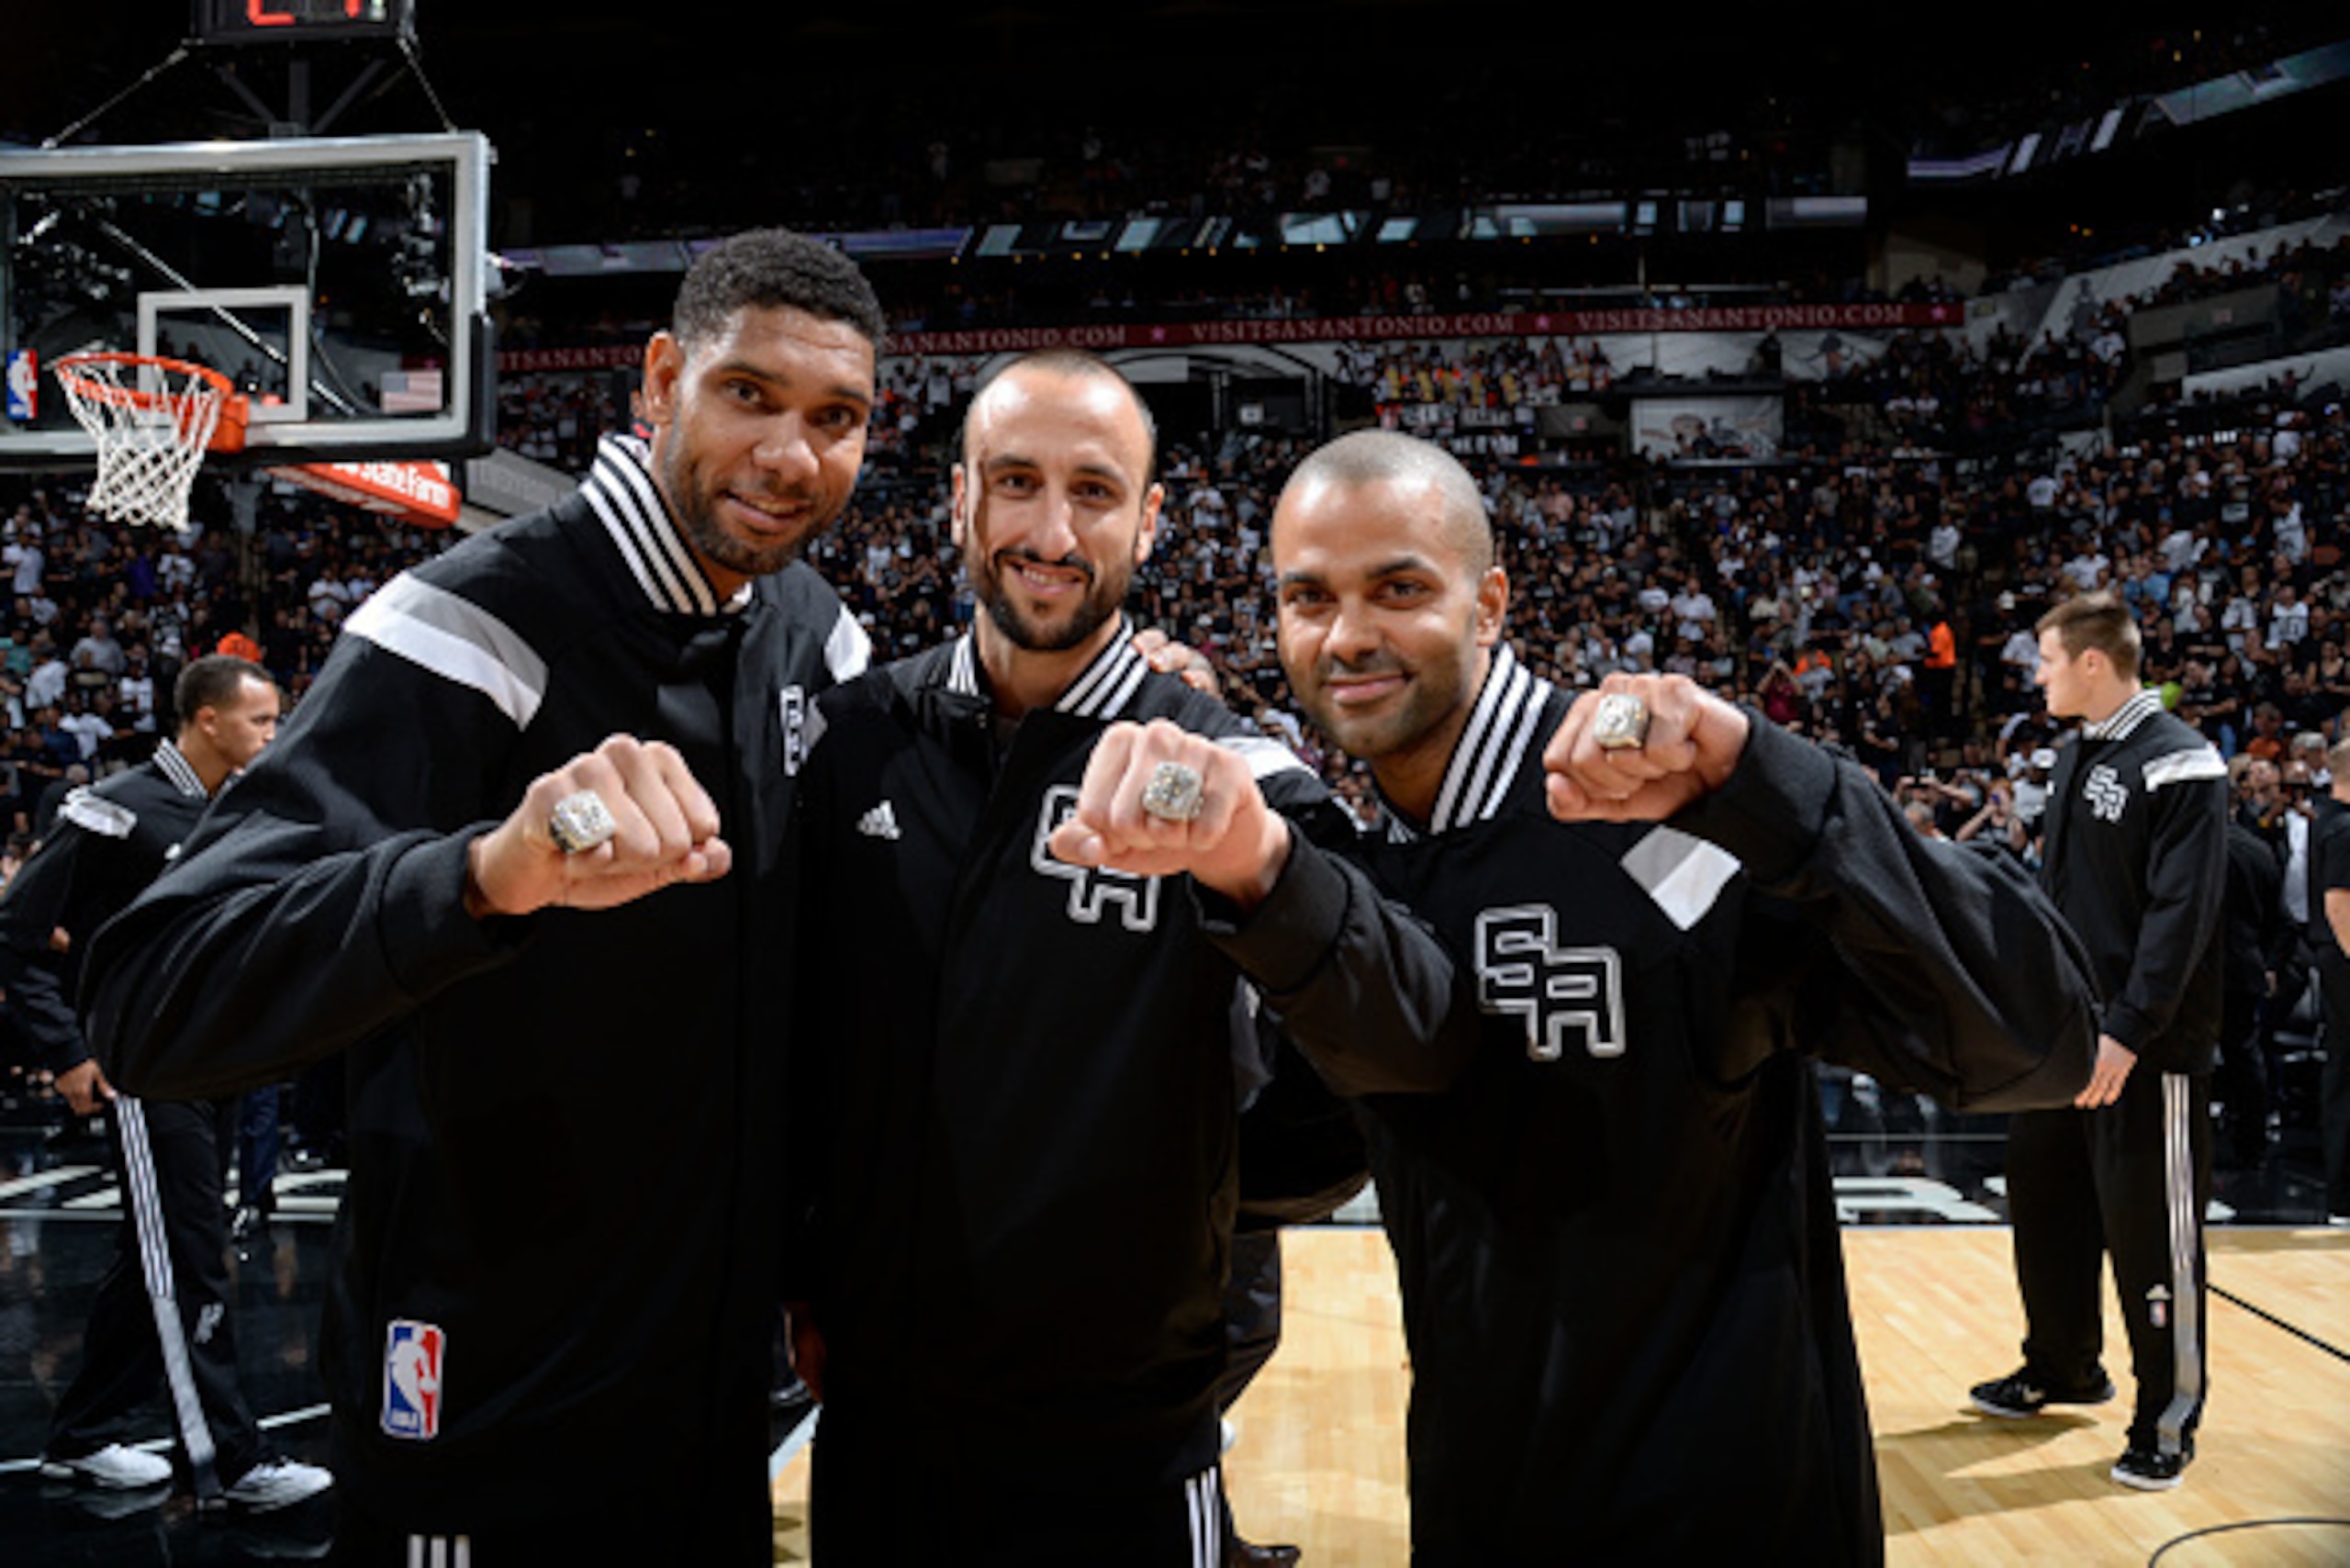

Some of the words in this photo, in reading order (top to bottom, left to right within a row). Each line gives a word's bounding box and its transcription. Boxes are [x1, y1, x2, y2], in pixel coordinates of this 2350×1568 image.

[1191, 313, 1515, 342] VISITSANANTONIO.COM
[1575, 305, 1905, 330] VISITSANANTONIO.COM
[884, 326, 1125, 353] SANANTONIO.COM
[408, 465, 450, 510] Farm
[1474, 903, 1626, 1061] SA
